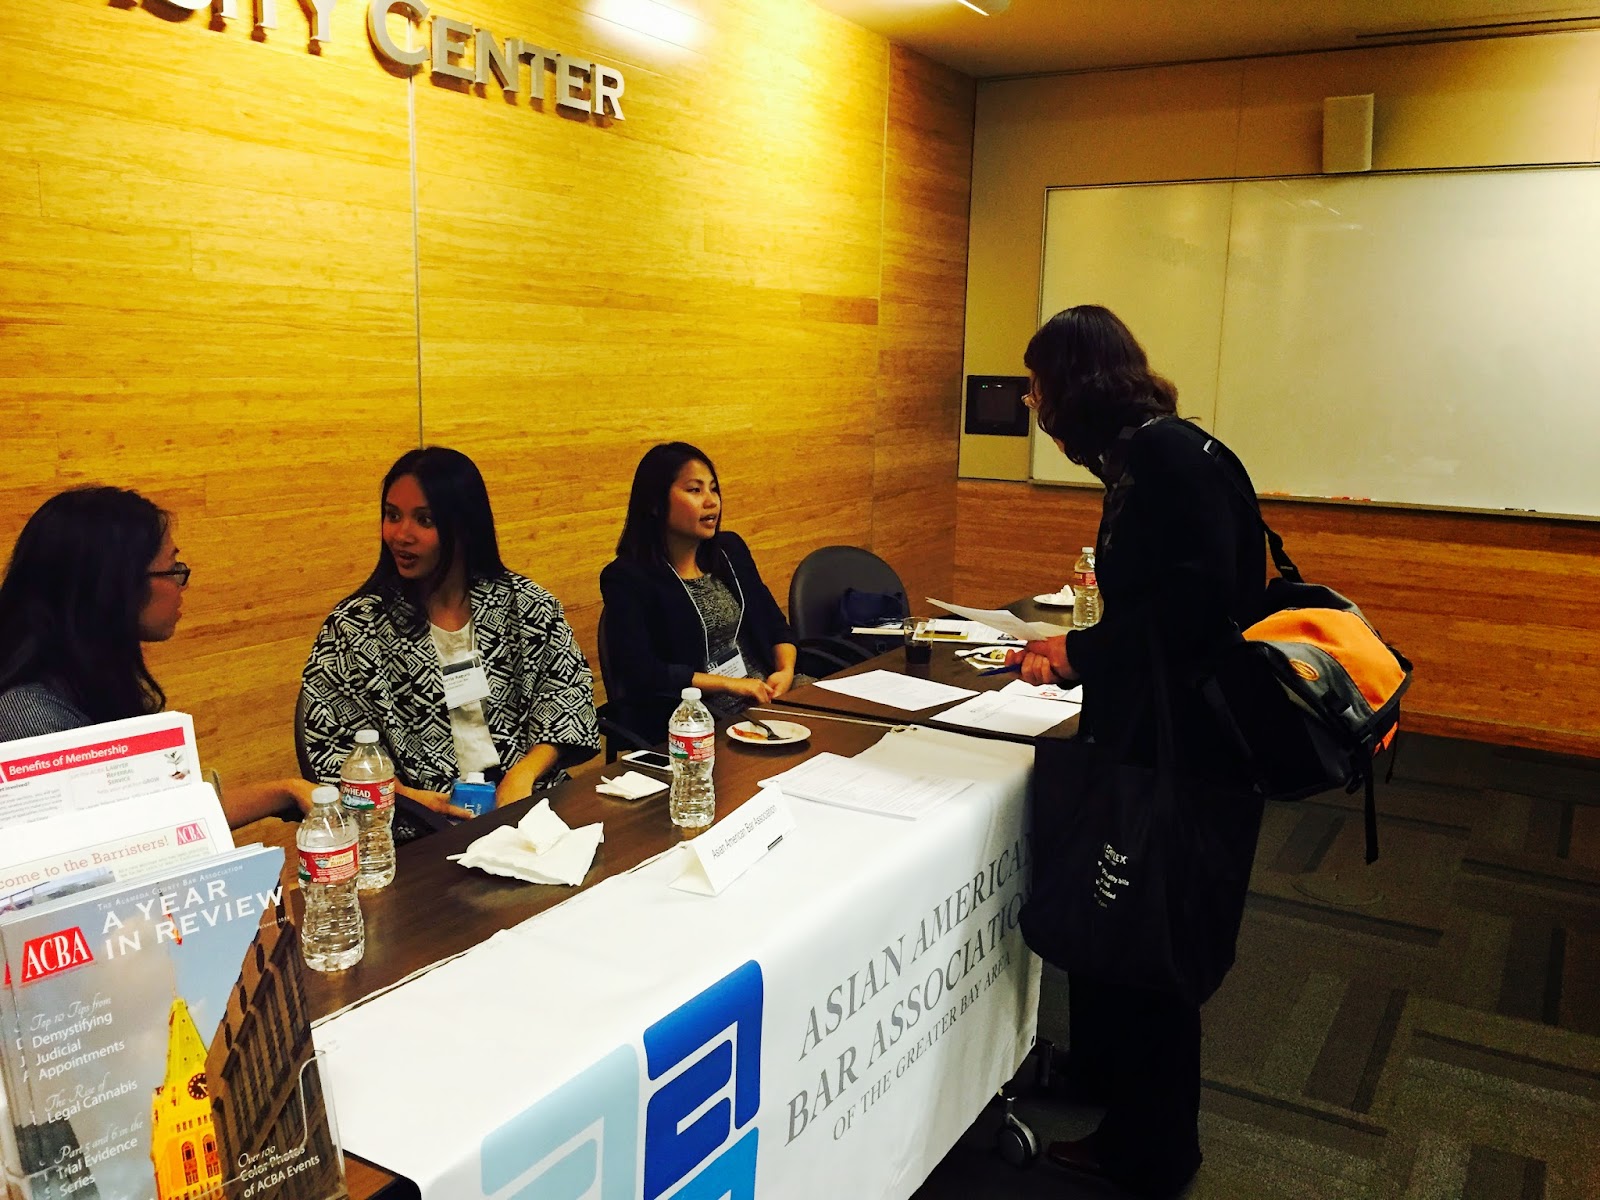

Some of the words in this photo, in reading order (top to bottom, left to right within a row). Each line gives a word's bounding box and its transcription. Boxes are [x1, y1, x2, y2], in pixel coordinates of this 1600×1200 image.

[367, 0, 625, 120] CENTER
[9, 760, 51, 776] Benefits
[52, 755, 64, 767] of
[65, 743, 129, 764] Membership
[177, 822, 205, 845] ACBA
[711, 844, 726, 860] Asian
[724, 828, 746, 849] American
[744, 822, 755, 833] Bar
[753, 804, 777, 826] Association
[44, 865, 60, 878] to
[64, 856, 88, 874] the
[91, 835, 169, 865] Barristers!
[102, 911, 125, 934] A
[135, 879, 227, 921] YEAR
[105, 930, 143, 960] IN
[154, 886, 284, 944] REVIEW
[25, 931, 94, 979] ACBA
[30, 1013, 50, 1032] Top
[54, 1013, 65, 1023] 10
[67, 1001, 90, 1018] Tips
[91, 992, 112, 1014] from
[798, 934, 906, 1062] ASIAN
[32, 1012, 113, 1049] Demystifying
[833, 1105, 856, 1141] OF
[860, 1070, 892, 1115] THE
[896, 1002, 957, 1078] GREATER
[960, 982, 983, 1016] BAY
[984, 952, 1011, 992] AREA
[35, 1040, 82, 1067] Judicial
[38, 1040, 126, 1081] Appointments
[48, 1101, 81, 1124] Legal
[83, 1078, 138, 1109] Cannabis
[784, 1046, 859, 1147] BAR
[56, 1161, 82, 1180] Trial
[85, 1136, 138, 1168] Evidence
[238, 1152, 259, 1168] Over
[261, 1145, 276, 1158] 100
[240, 1162, 268, 1182] Color
[269, 1146, 306, 1168] Photos
[243, 1183, 255, 1198] of
[257, 1170, 286, 1193] ACBA
[286, 1155, 320, 1178] Events
[59, 1173, 96, 1198] Series
